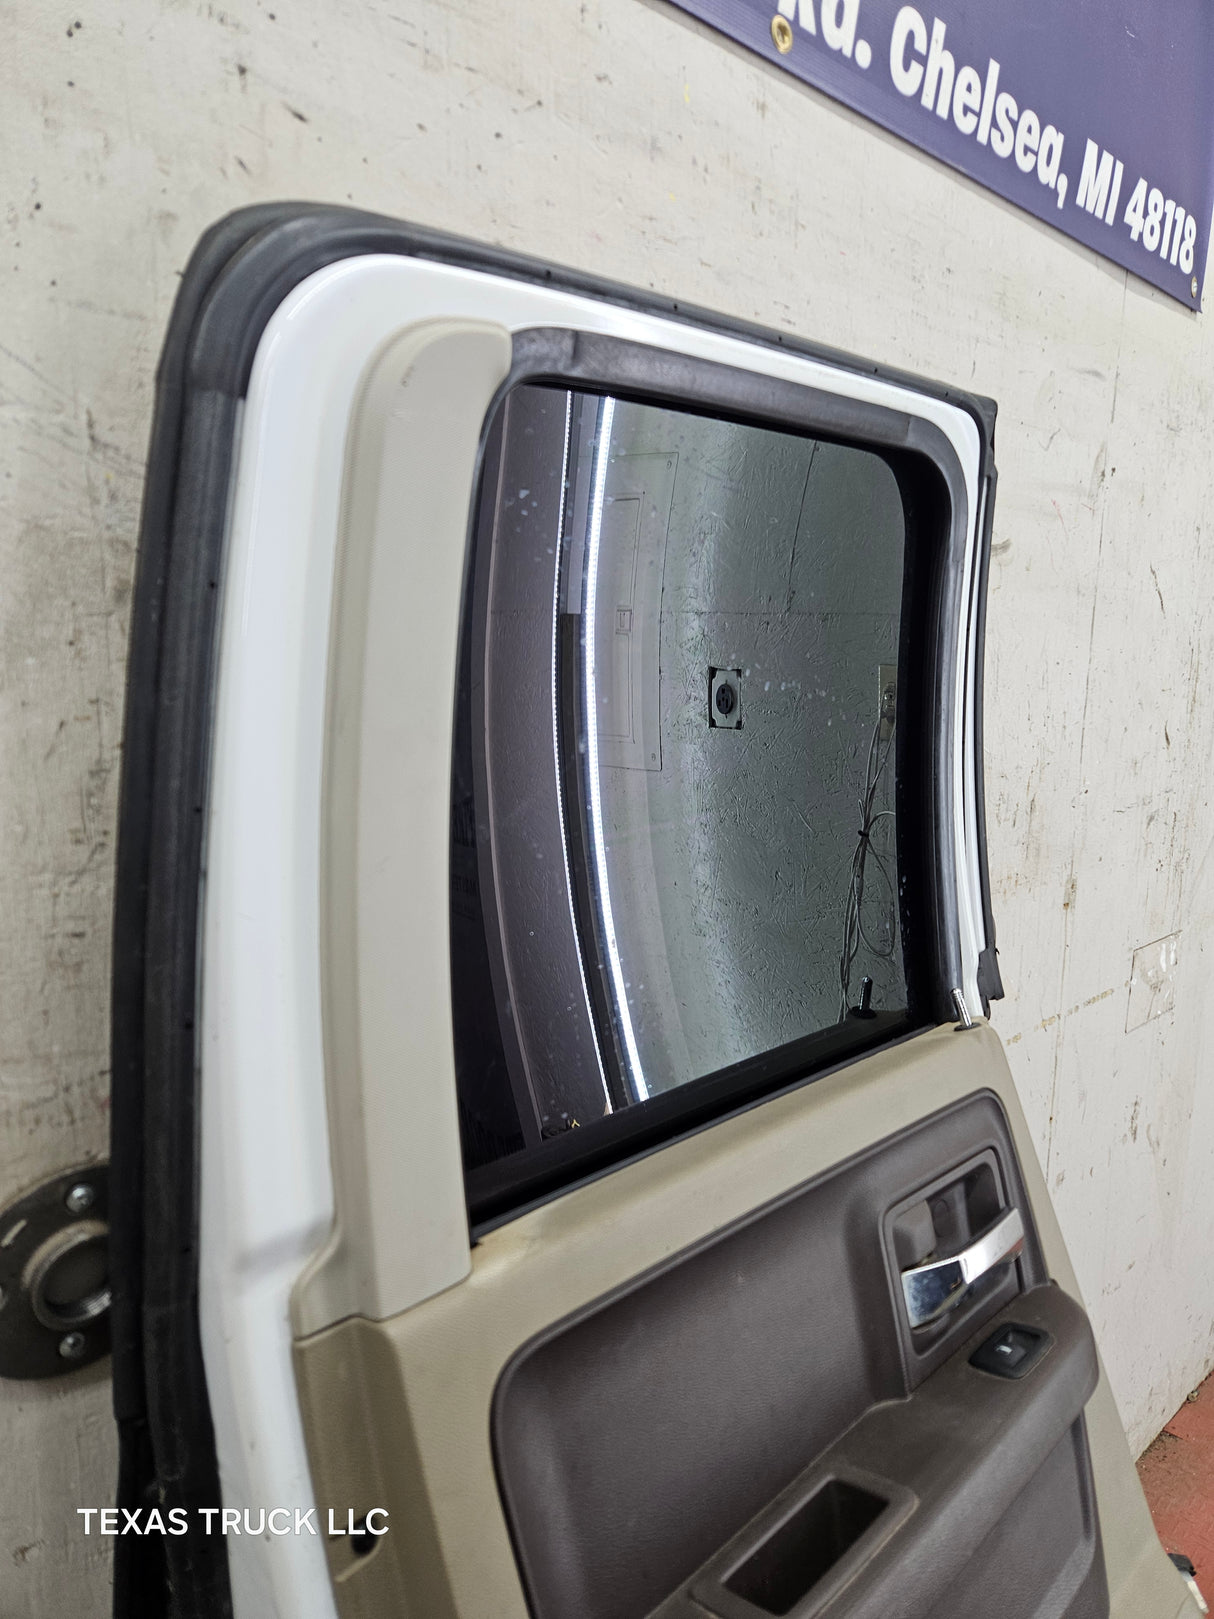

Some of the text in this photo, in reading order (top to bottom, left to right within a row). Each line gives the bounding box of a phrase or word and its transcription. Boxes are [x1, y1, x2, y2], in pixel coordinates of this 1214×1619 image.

[777, 0, 1197, 275] d. Chelsea, MI 48118
